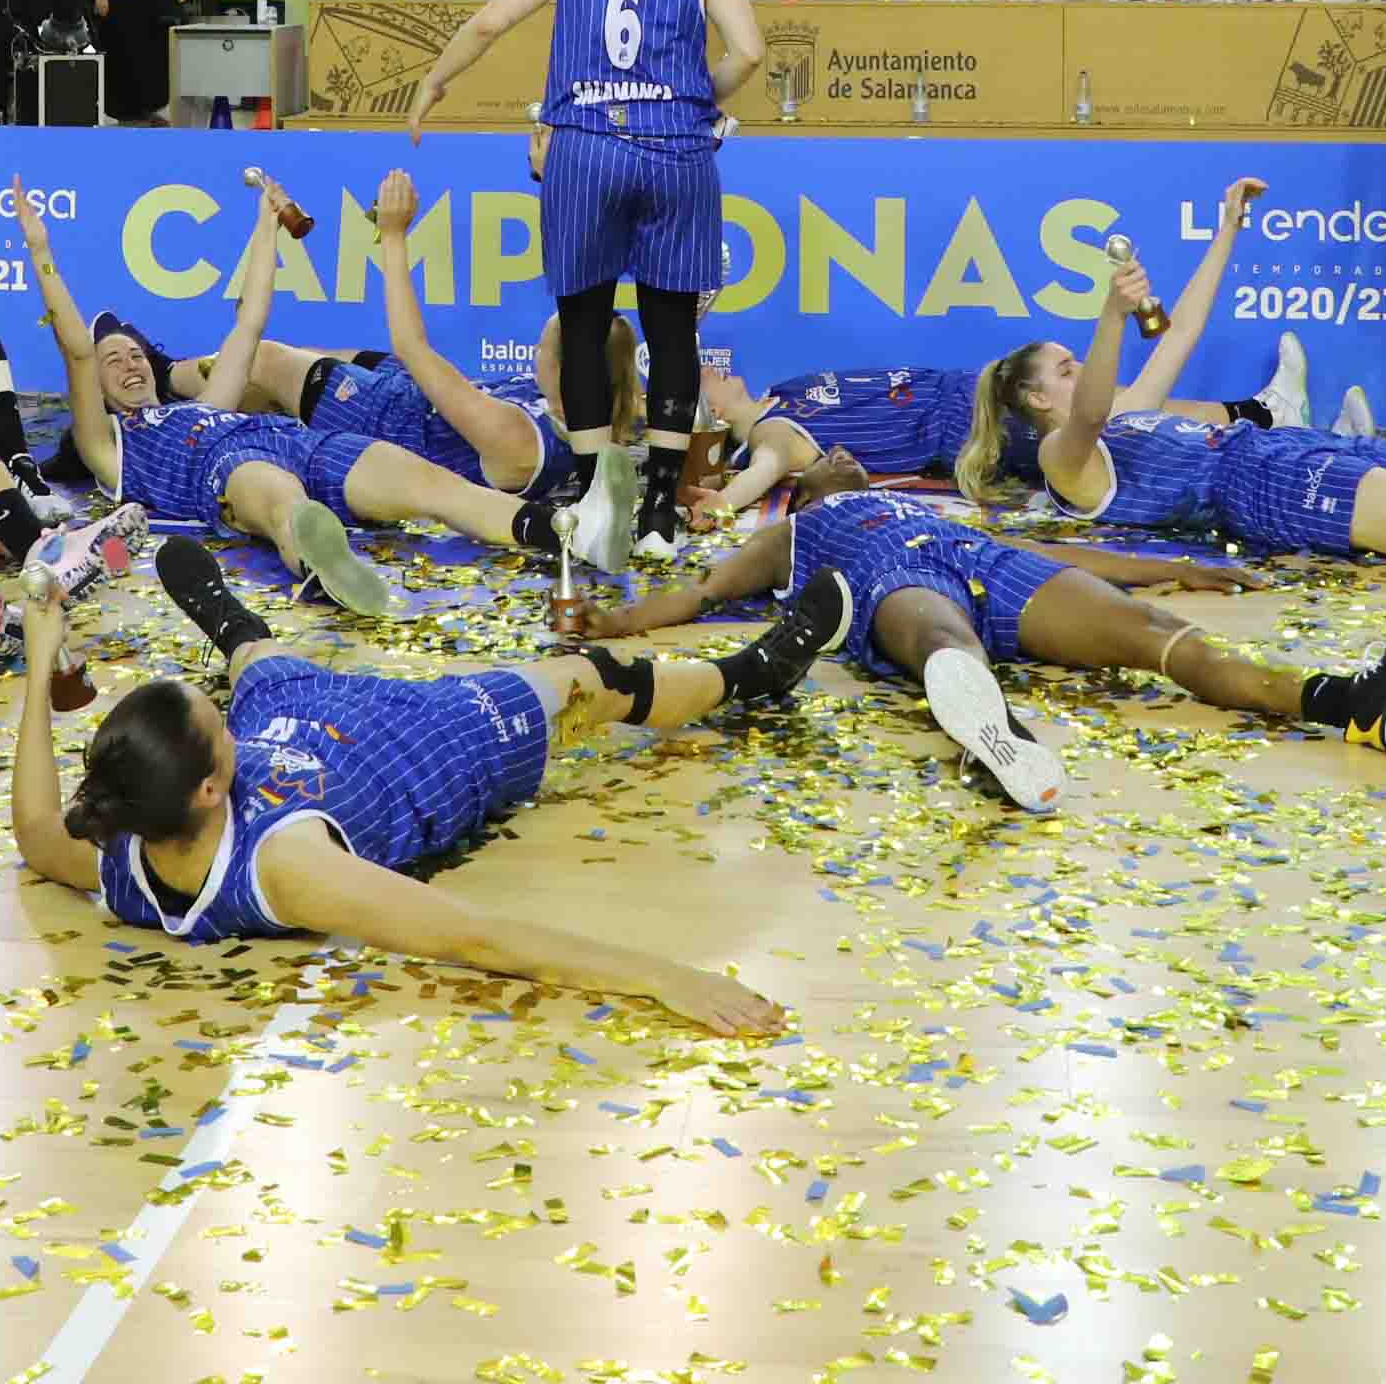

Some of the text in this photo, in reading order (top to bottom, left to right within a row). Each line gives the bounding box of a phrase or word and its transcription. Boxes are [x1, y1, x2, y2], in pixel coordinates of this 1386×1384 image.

[827, 49, 977, 74] Ayuntamiento
[572, 80, 673, 105] SALAMANCA
[827, 78, 977, 100] de Salamanca
[121, 182, 1122, 320] CAMPONAS
[700, 357, 731, 366] UJER
